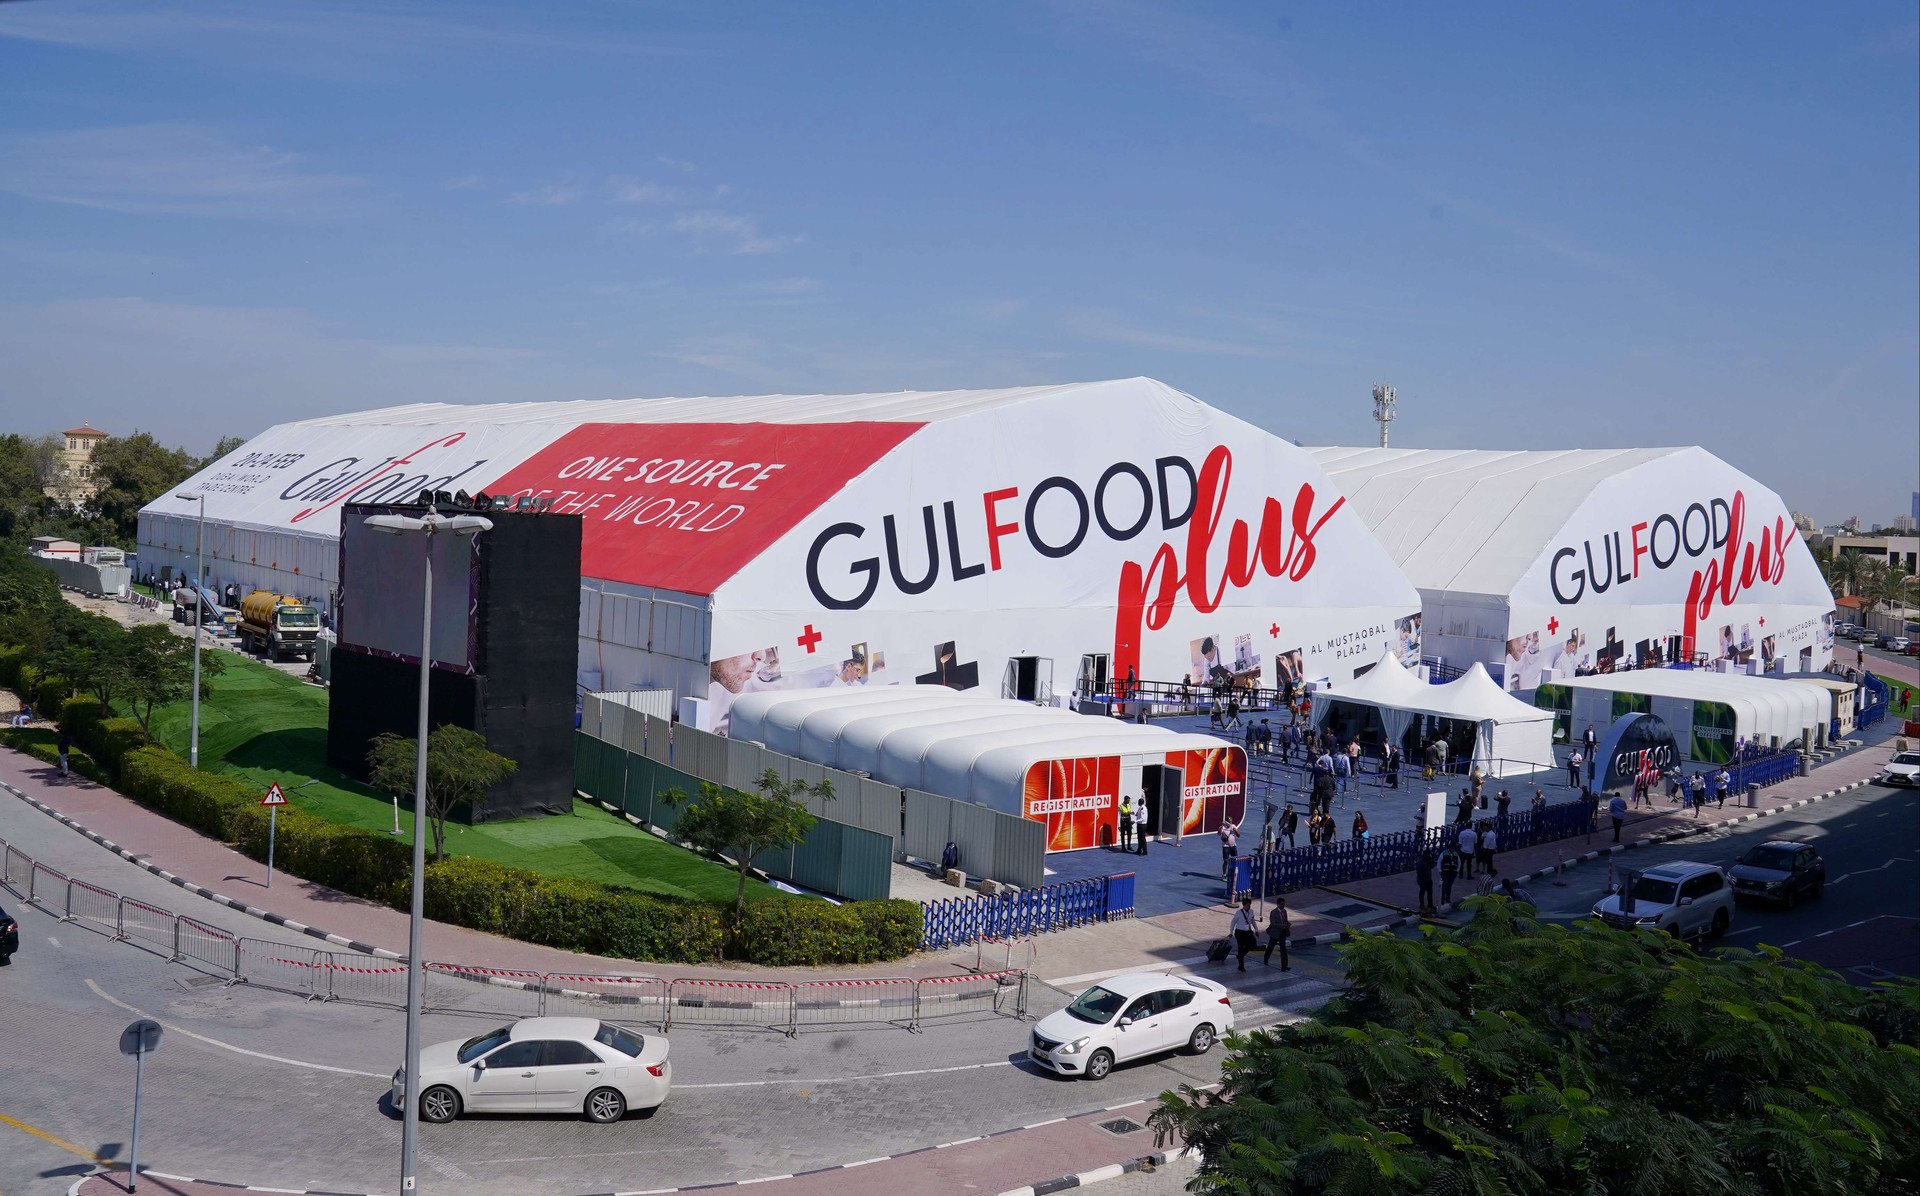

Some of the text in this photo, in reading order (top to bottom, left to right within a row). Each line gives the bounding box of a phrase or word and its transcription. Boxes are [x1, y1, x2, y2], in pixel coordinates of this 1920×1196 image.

[266, 453, 305, 469] FEB
[557, 456, 787, 491] ONE SOURCE
[553, 490, 616, 518] THE
[603, 496, 745, 532] WORLD
[806, 455, 1198, 610] GULFOOD
[1550, 498, 1731, 604] GULFOOD
[1114, 445, 1345, 713] plus
[1683, 490, 1797, 663] plus
[1311, 624, 1386, 655] AL MUSTAQBAL
[1779, 631, 1785, 639] AL
[1792, 631, 1808, 643] PLAZA
[1336, 643, 1368, 659] PLAZA
[1614, 745, 1672, 777] GULFOOD
[1033, 796, 1111, 812] REGISTRATION
[1184, 784, 1239, 797] GISTRATION
[407, 1180, 412, 1188] 6
